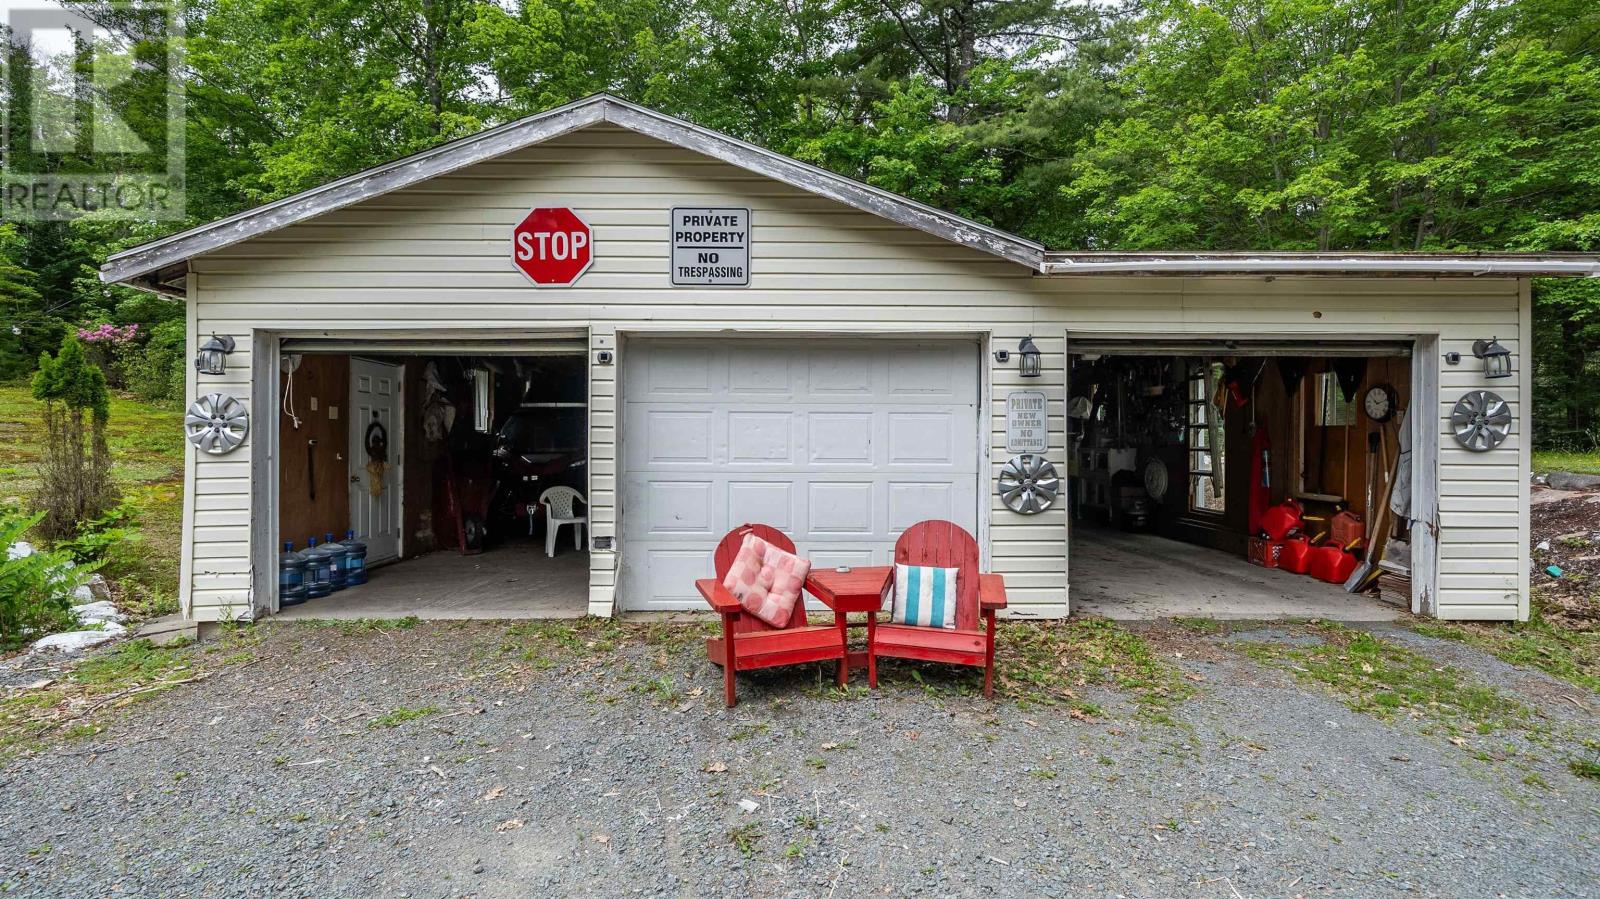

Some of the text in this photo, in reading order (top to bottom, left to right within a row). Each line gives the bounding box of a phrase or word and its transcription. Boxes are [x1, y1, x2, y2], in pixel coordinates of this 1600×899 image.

[683, 215, 738, 227] PRIVATE
[675, 231, 745, 243] PROPERTY
[517, 231, 588, 261] STOP
[698, 252, 719, 264] NO
[678, 266, 743, 278] TRESPASSING
[1011, 398, 1042, 409] PRIVATE
[1020, 430, 1032, 438] NO
